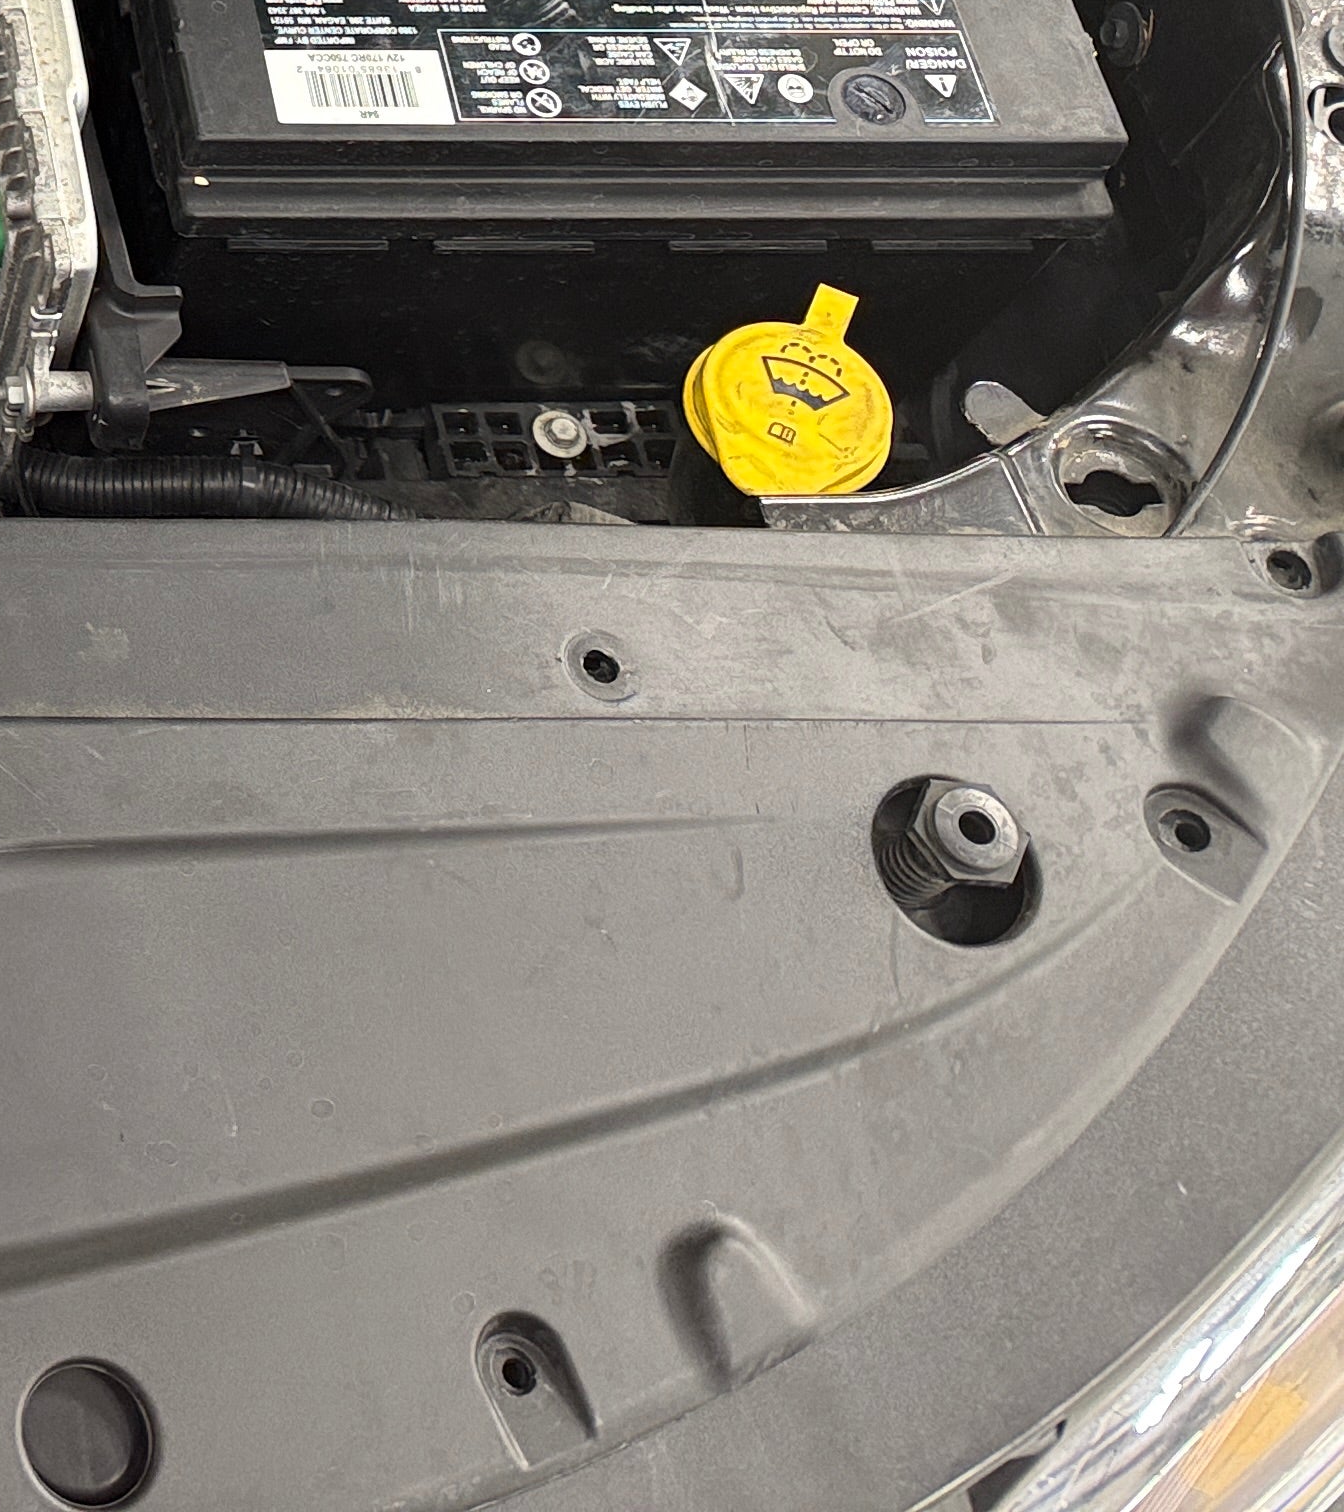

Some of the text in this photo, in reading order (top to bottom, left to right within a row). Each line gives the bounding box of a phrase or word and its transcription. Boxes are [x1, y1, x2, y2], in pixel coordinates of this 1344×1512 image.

[735, 5, 759, 13] Harm
[760, 4, 818, 14] Reproductive
[819, 5, 836, 14] and
[837, 6, 870, 15] Cancer
[871, 6, 922, 15] WARNING:
[297, 16, 311, 24] MN
[364, 16, 390, 24] SUITE
[902, 19, 955, 28] WARNING:
[344, 26, 397, 34] CORPORATE
[310, 36, 355, 44] IMPORTED
[607, 50, 653, 58] CAN CAUSE
[849, 47, 868, 55] NOT
[868, 47, 883, 55] DO
[905, 47, 958, 57] POISON
[308, 53, 348, 62] 750CCA
[387, 53, 405, 62] 12V
[462, 61, 516, 69] OF CHILDREN
[905, 58, 967, 69] DANGER!
[513, 105, 526, 113] NO
